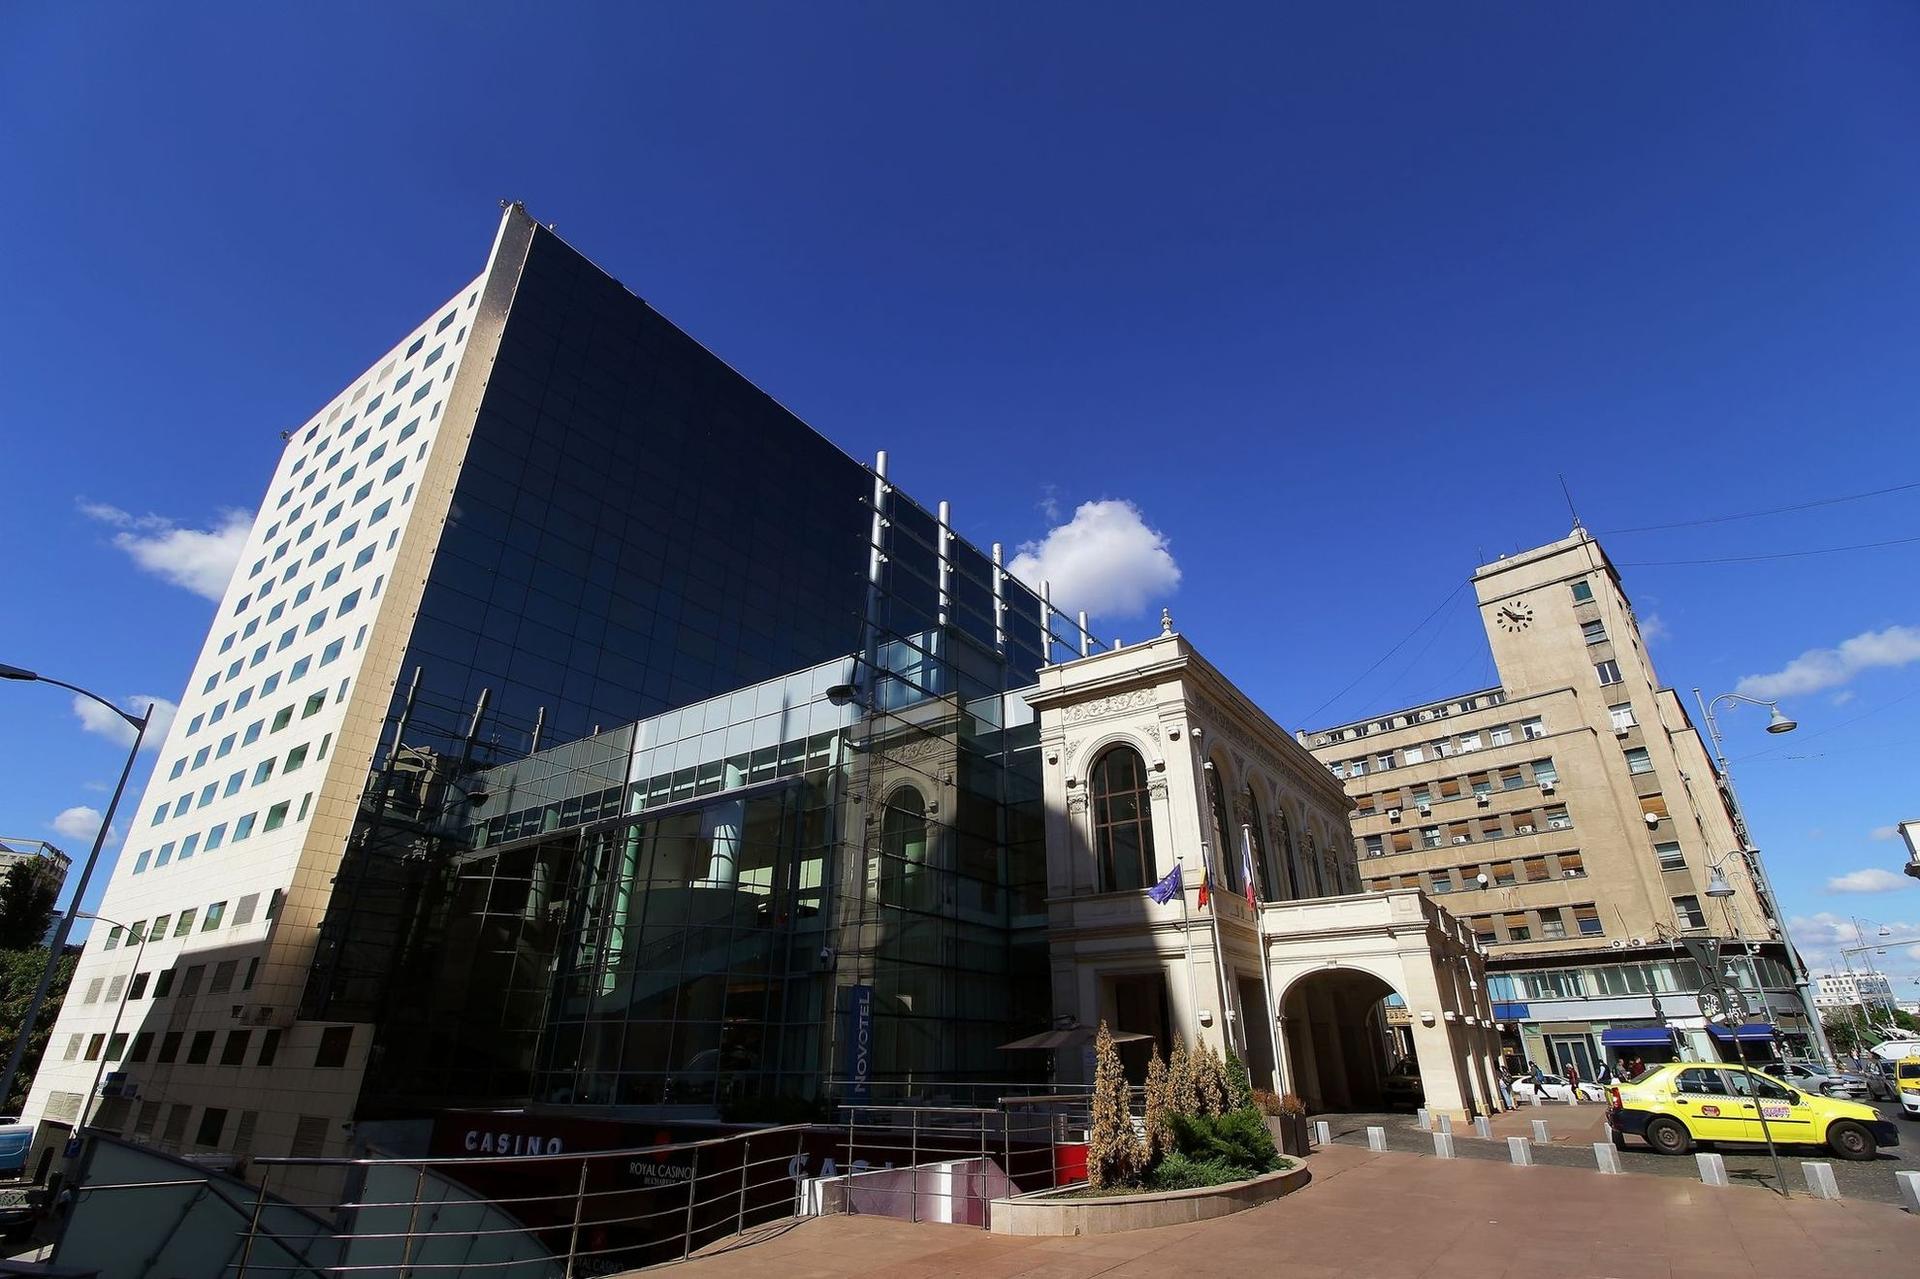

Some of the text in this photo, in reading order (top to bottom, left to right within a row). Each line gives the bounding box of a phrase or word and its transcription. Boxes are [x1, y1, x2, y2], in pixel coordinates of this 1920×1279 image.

[854, 991, 870, 1093] NOVOTEL
[465, 1130, 564, 1155] CASINO
[629, 1162, 693, 1179] ROYAL CASINO
